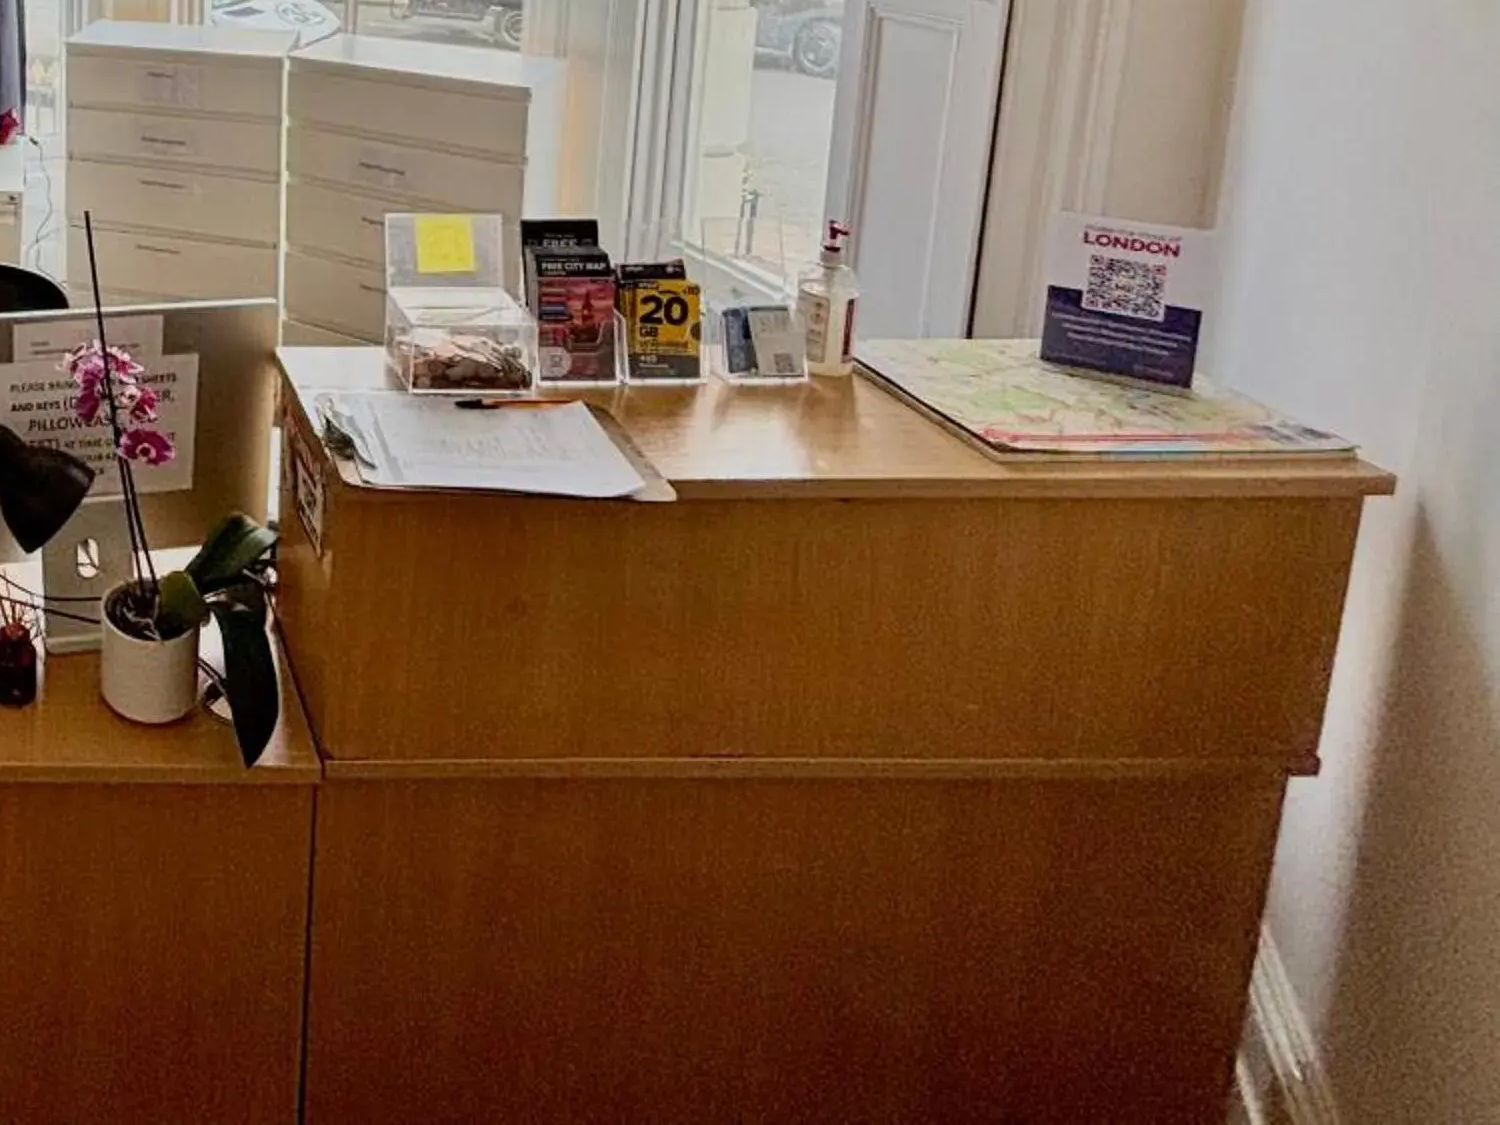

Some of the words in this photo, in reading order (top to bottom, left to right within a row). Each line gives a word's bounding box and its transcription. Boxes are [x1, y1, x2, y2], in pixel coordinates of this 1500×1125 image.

[1083, 230, 1182, 257] LONDON
[639, 295, 689, 325] 20
[639, 326, 659, 336] GB
[10, 381, 45, 393] PLEASE
[11, 401, 34, 412] AND
[36, 401, 61, 411] KEYS
